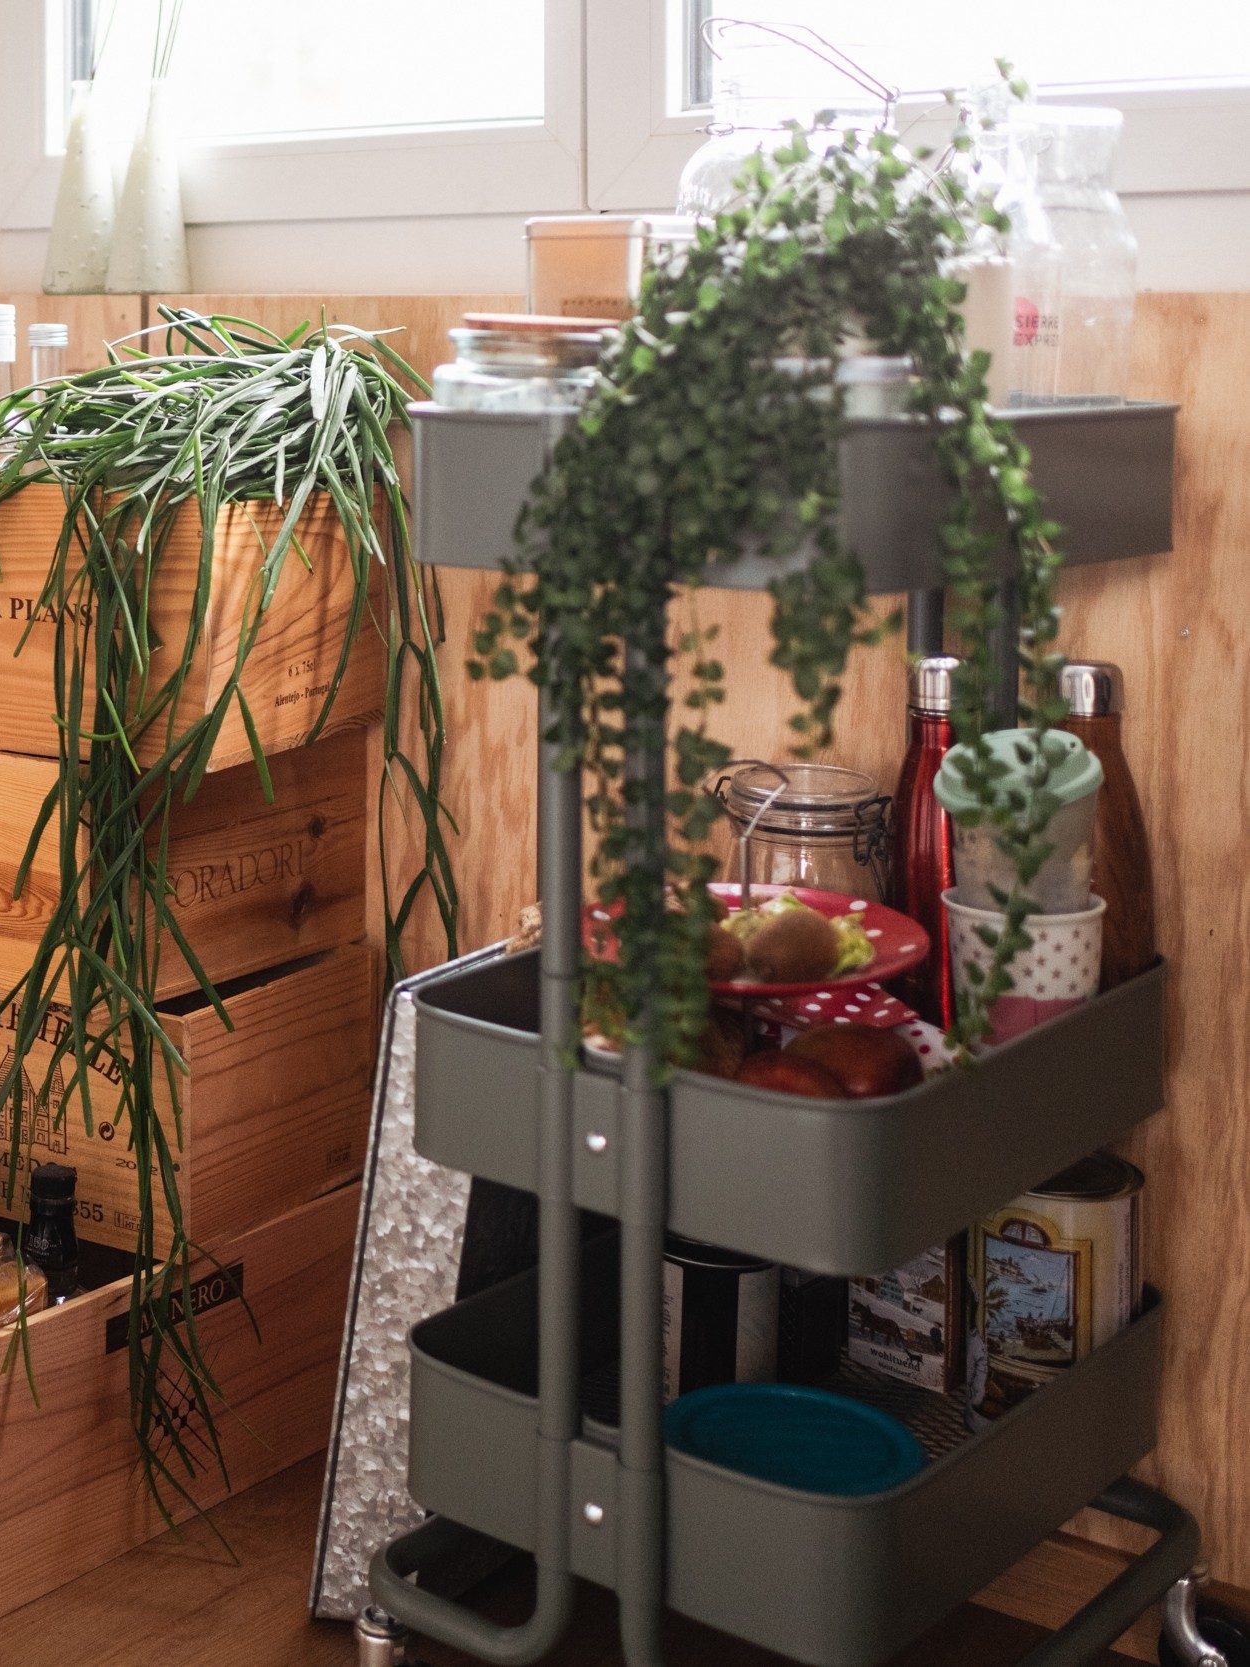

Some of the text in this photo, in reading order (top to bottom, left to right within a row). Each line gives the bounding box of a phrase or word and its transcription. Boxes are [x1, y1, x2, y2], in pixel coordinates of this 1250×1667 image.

[165, 840, 306, 909] ORADORI
[115, 1157, 158, 1176] 202
[870, 1347, 921, 1372] wohltuend
